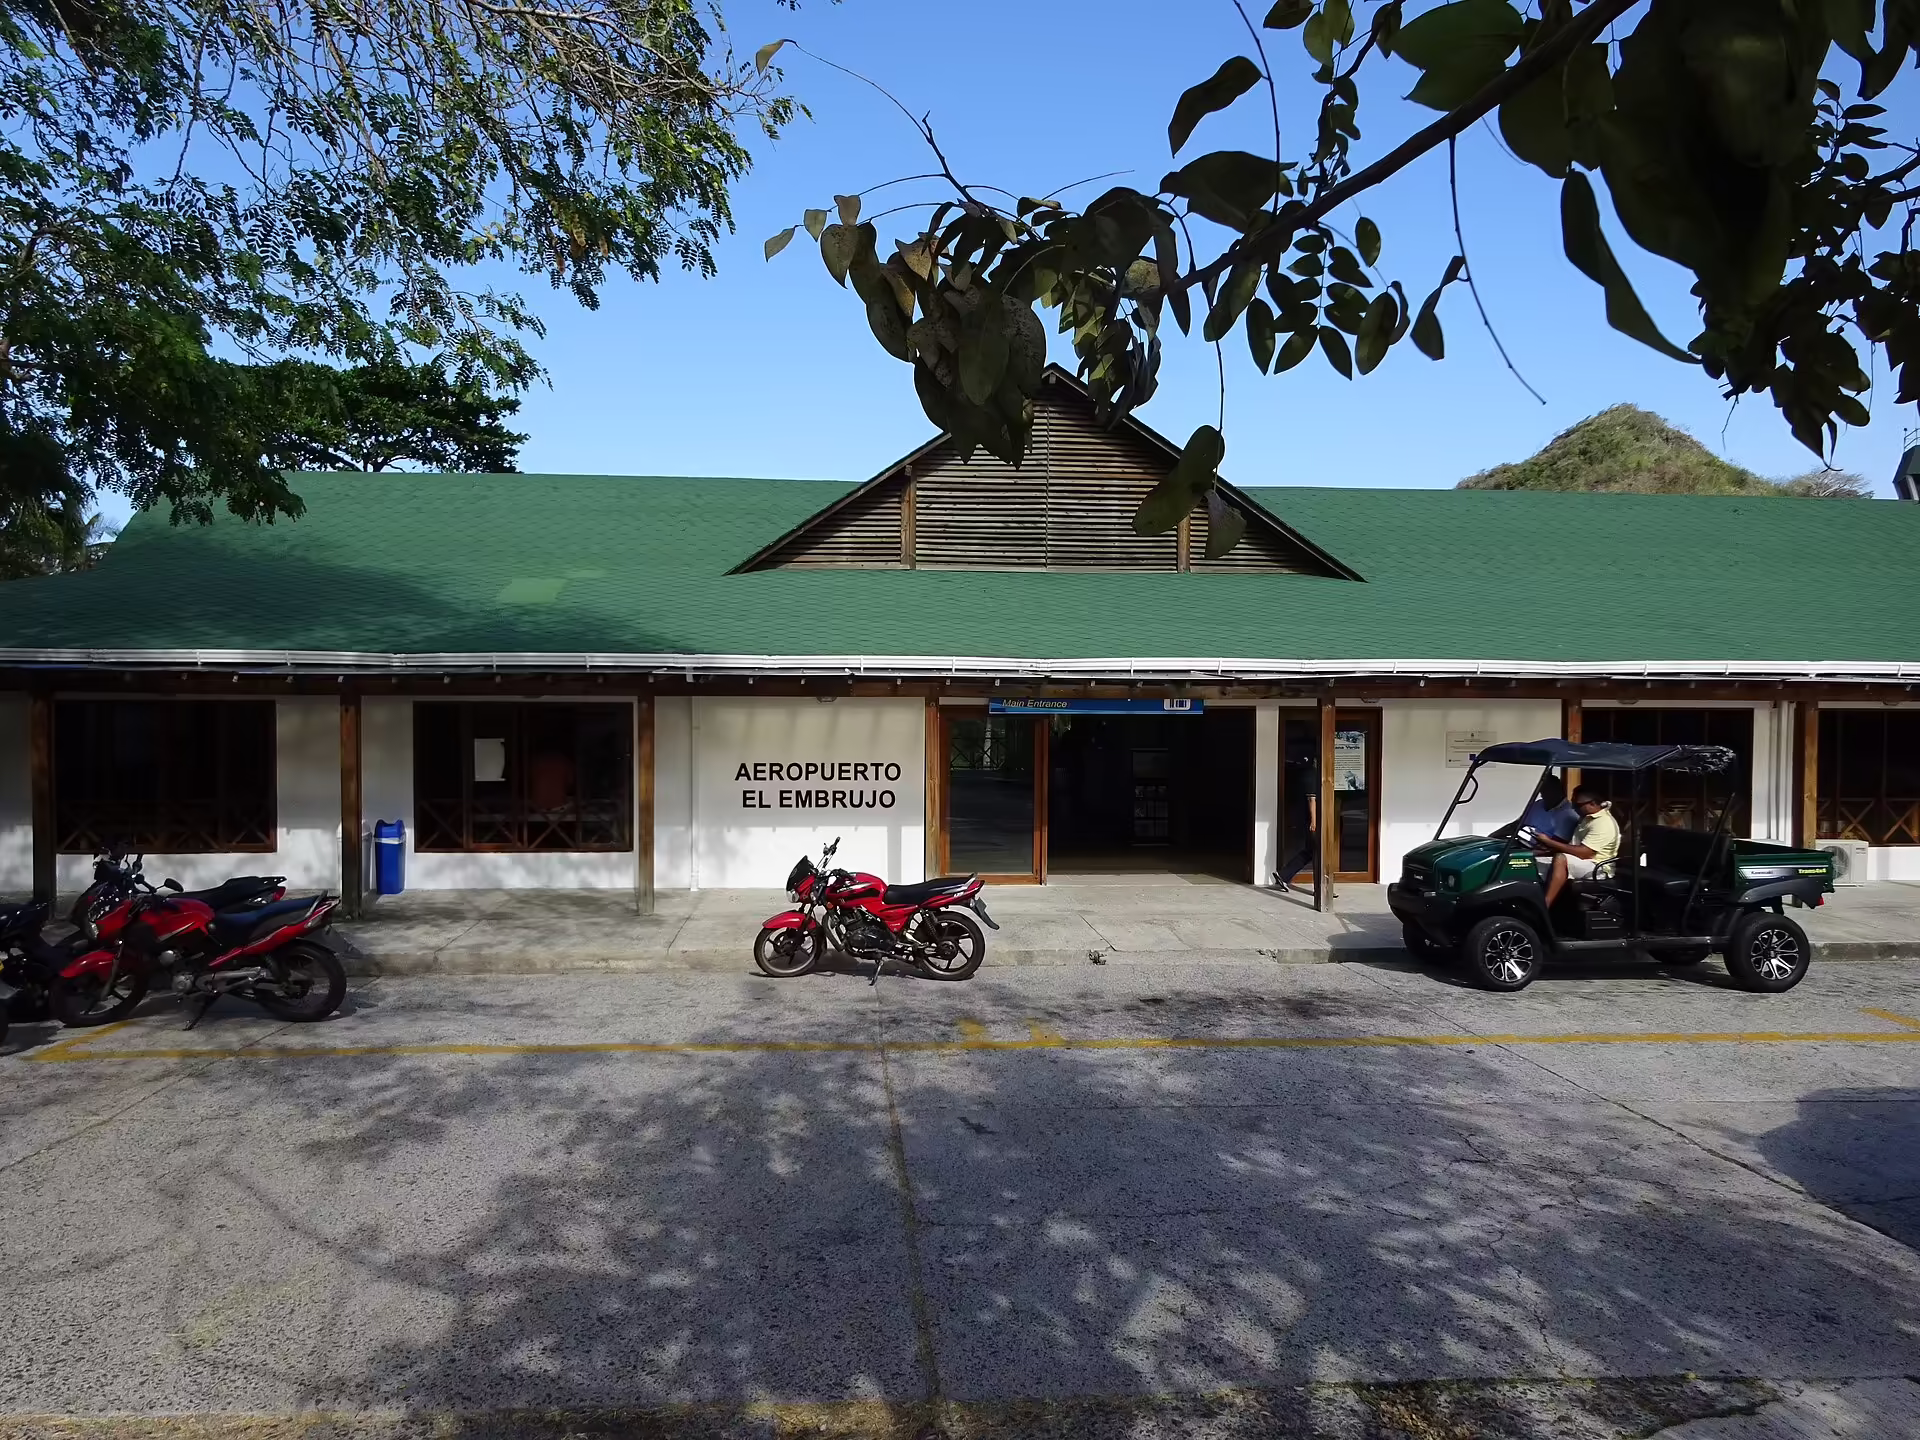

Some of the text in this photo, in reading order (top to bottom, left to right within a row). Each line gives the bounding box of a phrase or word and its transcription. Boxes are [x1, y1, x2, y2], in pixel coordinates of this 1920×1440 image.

[1002, 699, 1068, 708] Main Entrance
[734, 762, 902, 781] AEROPUERTO
[742, 789, 896, 809] EL EMBRUJO
